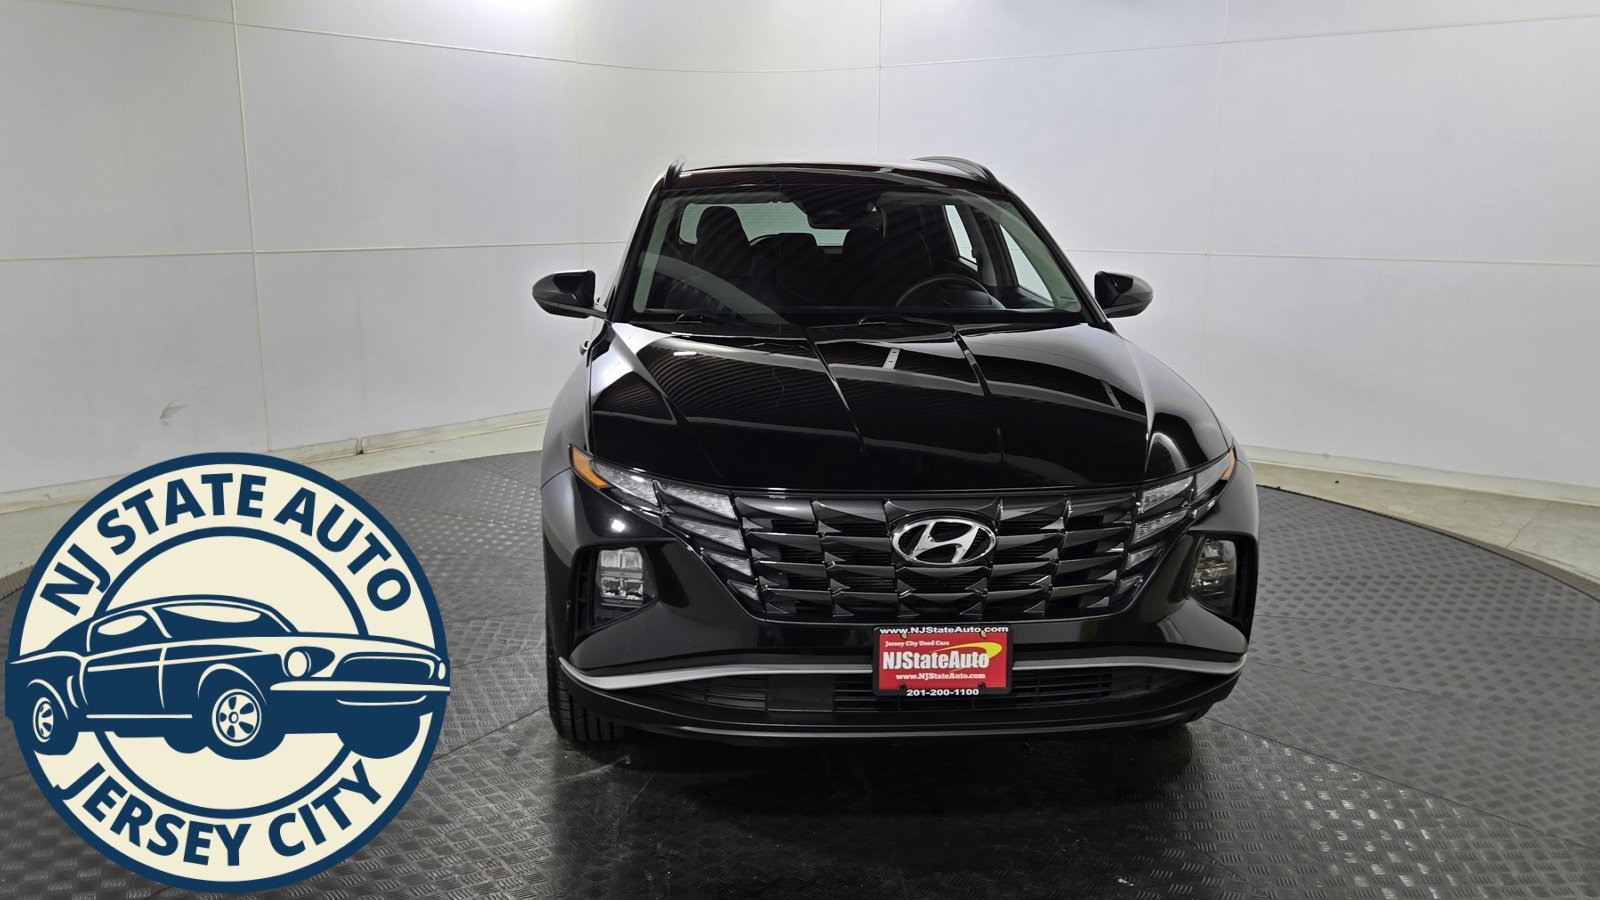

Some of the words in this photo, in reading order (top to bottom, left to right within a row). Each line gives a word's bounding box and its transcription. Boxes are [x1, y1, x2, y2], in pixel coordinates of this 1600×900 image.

[879, 626, 1009, 634] www.NJStateAuto.com
[882, 651, 990, 670] NJStateAuto
[906, 688, 980, 697] 201-200-1100
